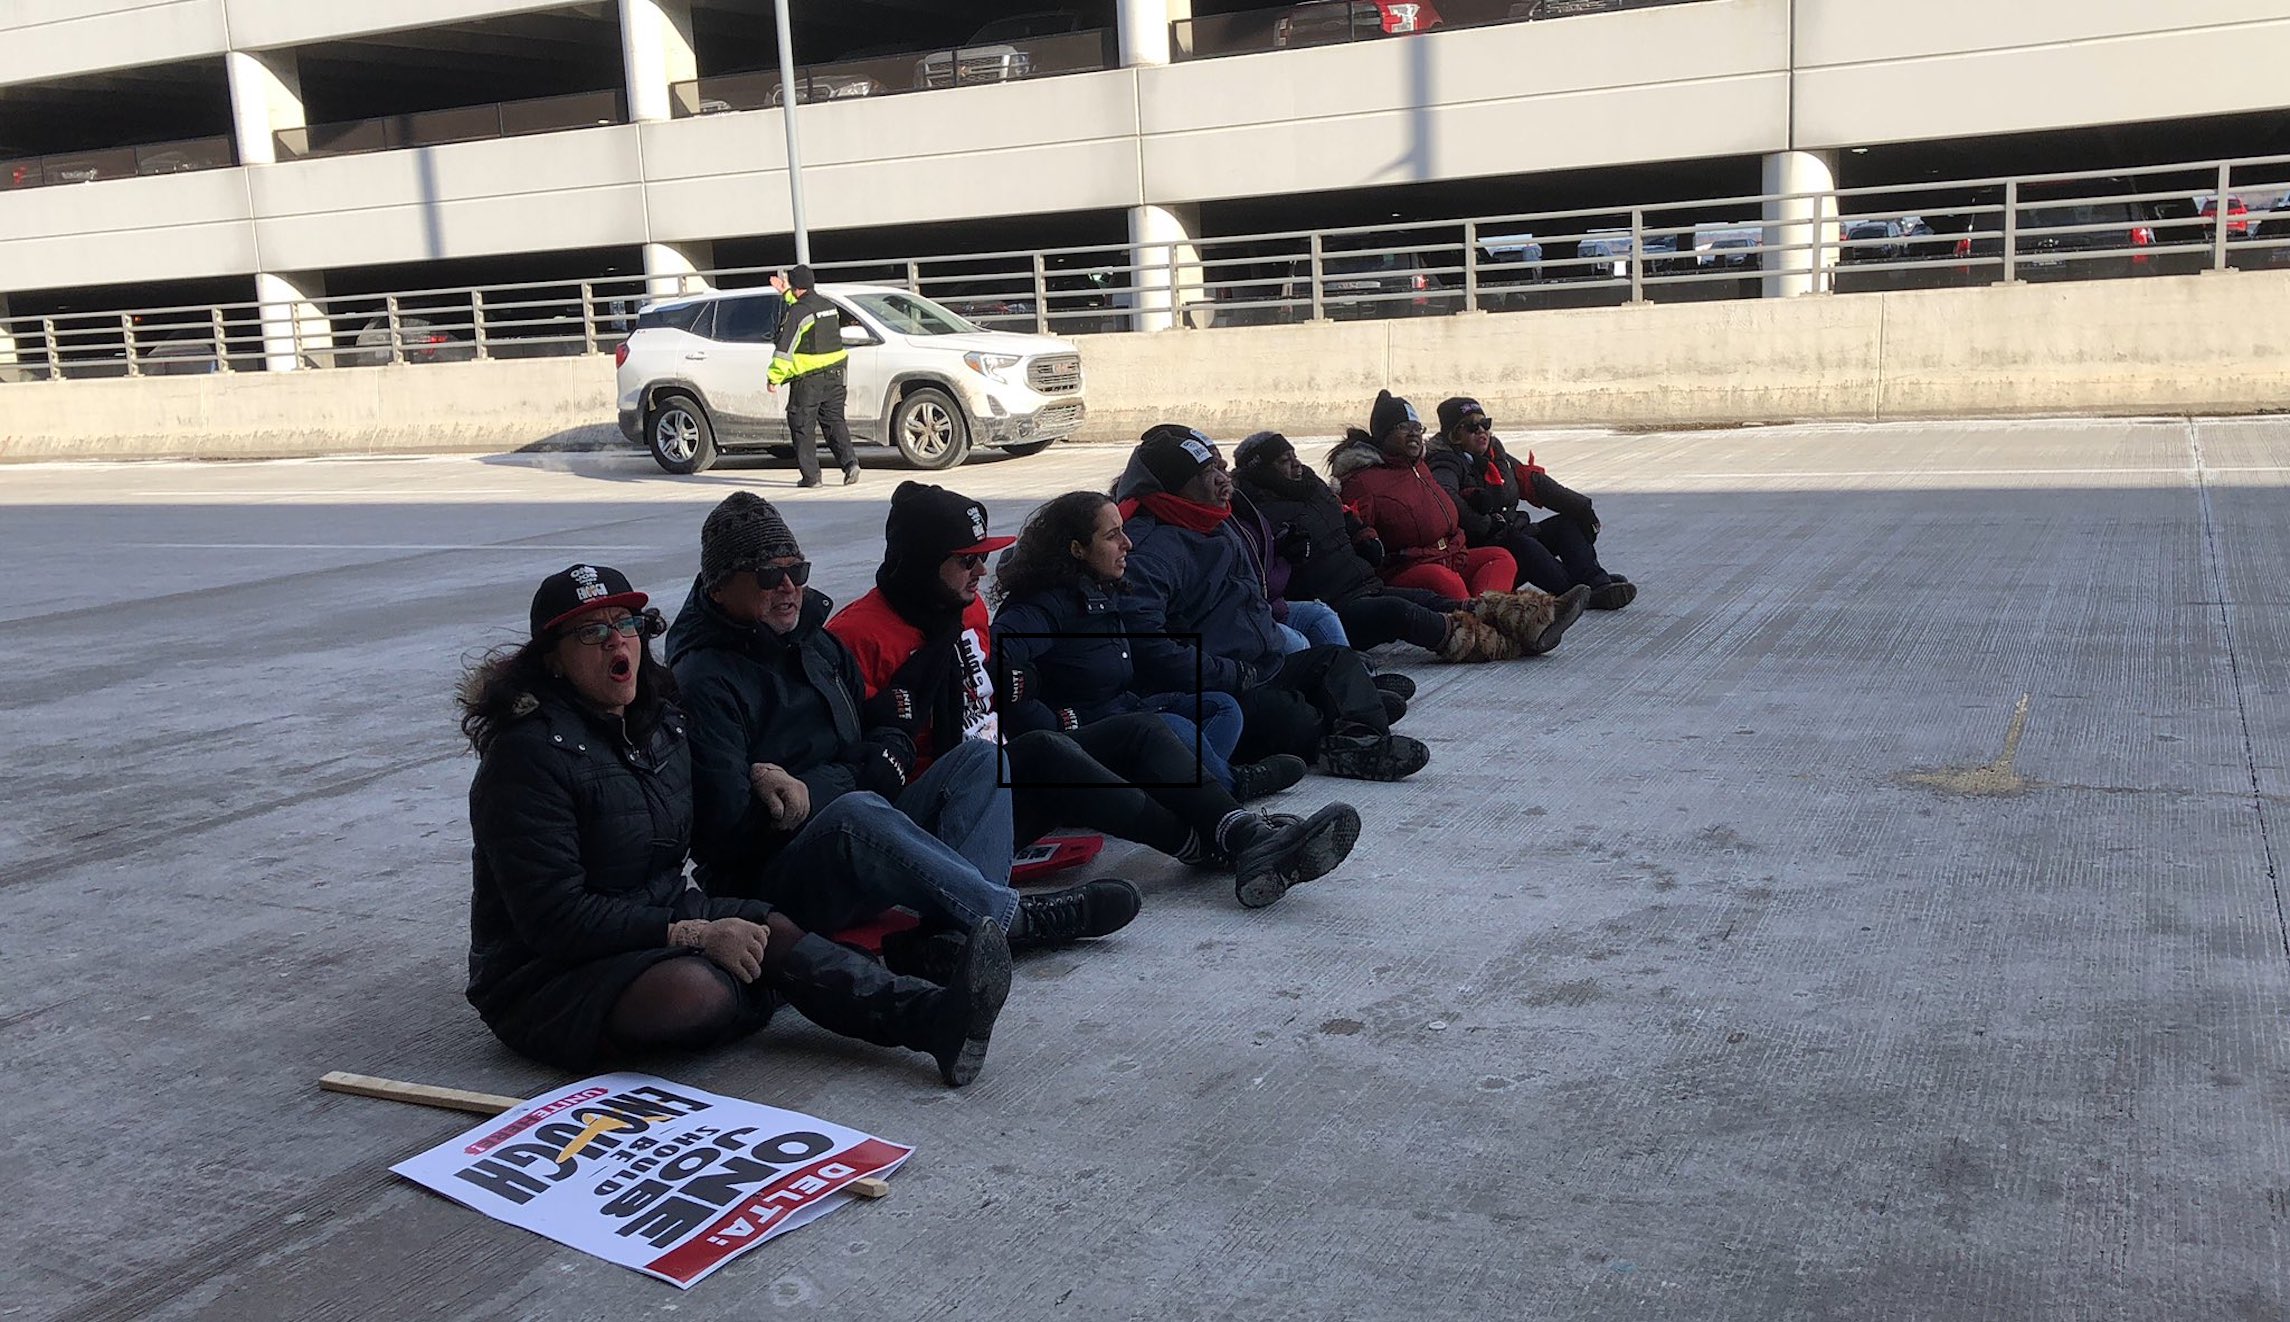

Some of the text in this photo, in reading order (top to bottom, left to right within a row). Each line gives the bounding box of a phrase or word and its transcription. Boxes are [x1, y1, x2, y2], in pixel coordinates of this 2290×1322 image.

[453, 1086, 714, 1205] ENOUGH
[594, 1125, 722, 1196] SHOULD
[600, 1126, 760, 1238] JOB
[609, 1136, 659, 1163] BE
[639, 1131, 834, 1249] ONE
[706, 1162, 857, 1246] DELTA:
